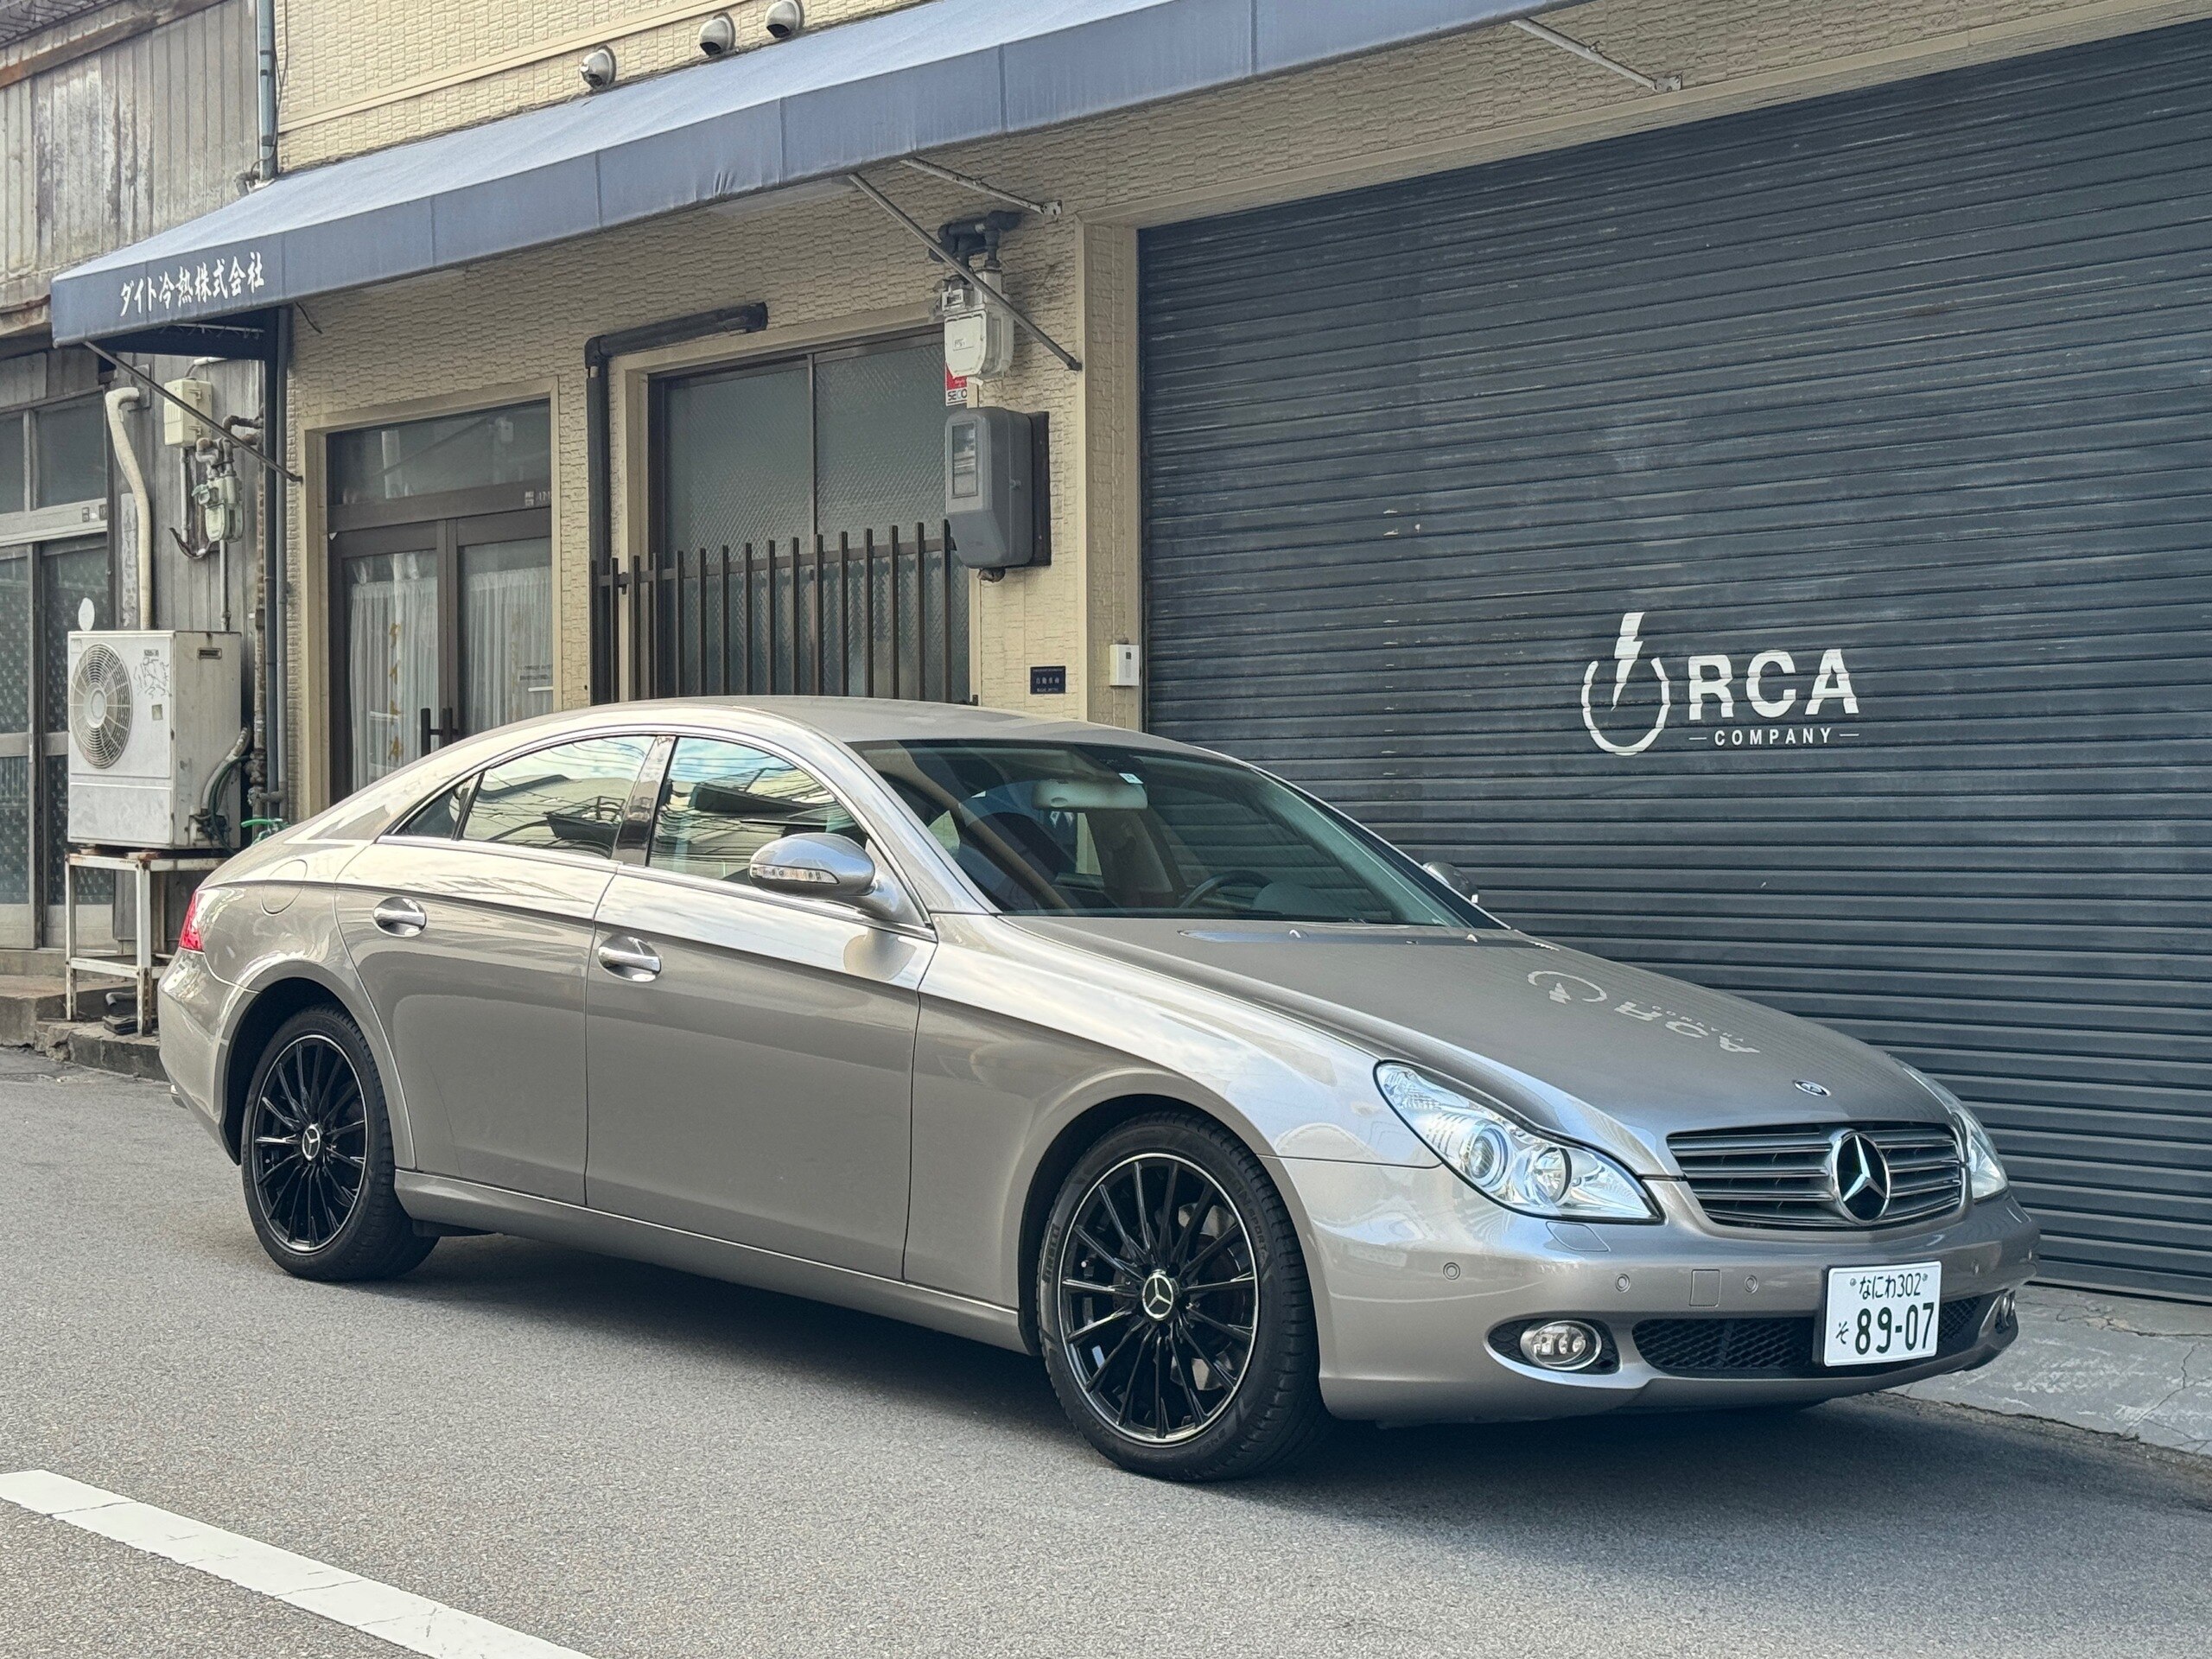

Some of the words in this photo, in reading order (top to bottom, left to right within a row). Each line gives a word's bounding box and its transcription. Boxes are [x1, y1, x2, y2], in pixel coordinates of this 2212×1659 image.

[119, 251, 264, 317] ダイト冷熱株式会社
[1713, 728, 1832, 747] COMPANY
[1835, 1320, 1850, 1345] そ
[1855, 1301, 1935, 1356] 89-07
